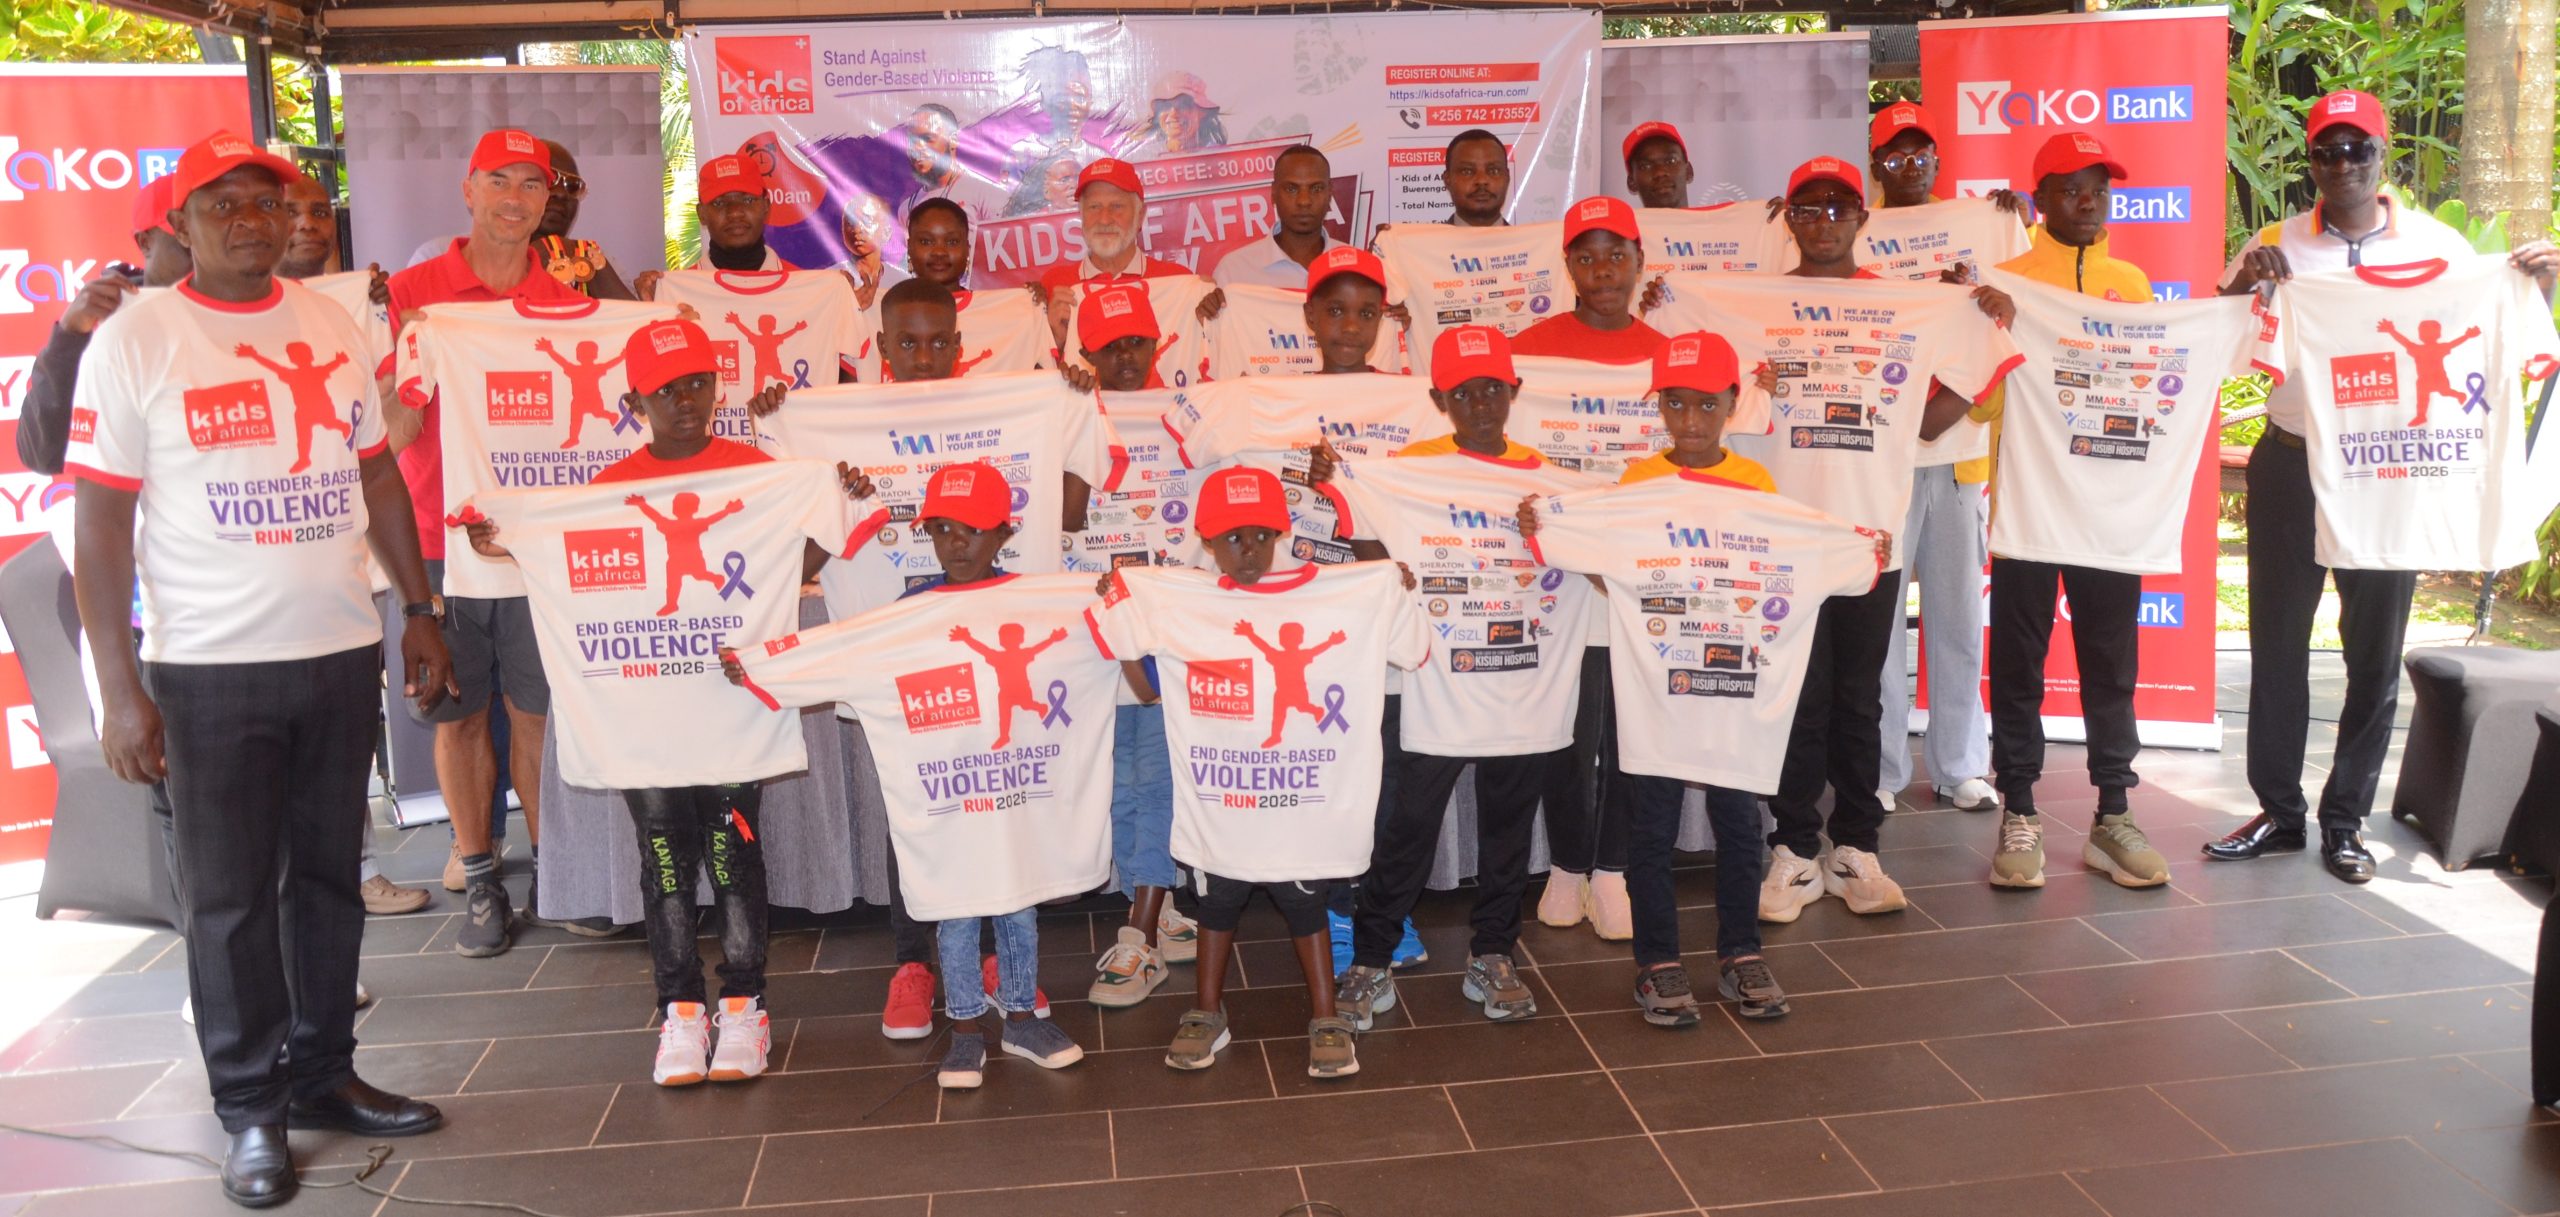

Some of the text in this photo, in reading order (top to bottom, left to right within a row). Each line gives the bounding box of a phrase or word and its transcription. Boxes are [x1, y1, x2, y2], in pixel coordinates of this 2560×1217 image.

[823, 49, 926, 67] Stand Against
[824, 69, 995, 88] Gender-Based Violence
[1390, 67, 1491, 80] REGISTER ONLINE AT:
[1389, 86, 1529, 101] https://kidsofafrica-run.com/
[723, 94, 810, 112] of africa
[2112, 90, 2188, 120] Bank
[1432, 107, 1532, 122] +256 742 173552
[1392, 151, 1442, 163] REGISTER
[1172, 162, 1213, 183] FEE:
[1218, 155, 1275, 178] 30,000
[1402, 174, 1432, 182] Kids of
[1402, 202, 1424, 210] Total
[2110, 192, 2185, 220] Bank
[983, 217, 1085, 273] KIDS
[1183, 191, 1346, 246] AFRA
[1765, 328, 1805, 336] ROKO
[2336, 370, 2393, 390] kids
[491, 388, 549, 406] kids
[2338, 387, 2394, 401] of africa
[190, 401, 267, 430] kids
[492, 406, 549, 418] of africa
[1794, 409, 1820, 420] ISZL
[195, 422, 270, 444] of africa
[946, 428, 1001, 442] WE ARE ON
[2339, 428, 2484, 445] END GENDER-BASED
[946, 438, 1000, 452] YOUR SIDE
[1128, 444, 1160, 453] ARE ON
[491, 448, 632, 464] END GENDER-BASED
[1140, 454, 1159, 462] SIDE
[2341, 442, 2470, 466] VIOLENCE
[492, 464, 608, 488] VIOLENC
[2377, 466, 2448, 480] RUN 2026
[206, 468, 362, 497] END GENDER-BASED
[208, 488, 351, 526] VIOLENCE
[255, 524, 335, 546] RUN 2026
[1085, 533, 1131, 545] MMAKS
[1420, 536, 1506, 549] ROKO RUN
[1722, 532, 1769, 544] WE ARE ON
[1722, 542, 1769, 554] YOUR SIDE
[571, 548, 640, 570] kids
[906, 556, 936, 568] ISZL
[1419, 561, 1464, 570] SHERATON
[1636, 556, 1729, 569] ROKO RUN
[574, 568, 640, 584] of africa
[1462, 600, 1511, 610] MMAKS
[2140, 596, 2178, 624] nk
[576, 615, 744, 637] END GENDER-BASED
[1680, 620, 1729, 633] MMAKS
[1454, 629, 1483, 642] ISZL
[578, 632, 727, 663] VIOLENCE
[1672, 649, 1699, 662] ISZL
[1475, 652, 1538, 667] KISUBI HOSPITAL
[622, 662, 704, 678] RUN 2026
[1190, 676, 1249, 698] kids
[1692, 678, 1755, 693] KISUBI HOSPITAL
[905, 686, 973, 713] kids
[1192, 696, 1250, 712] of africa
[910, 706, 975, 725] of africa
[918, 744, 1060, 776] END GENDER-BASED
[1190, 746, 1336, 764] END GENDER-BASED
[921, 762, 1048, 801] VIOLENCE
[1190, 762, 1320, 791] VIOLENCE
[963, 791, 1027, 814] RUN 2026
[1224, 794, 1299, 809] RUN 2026
[652, 836, 678, 894] KANAGA
